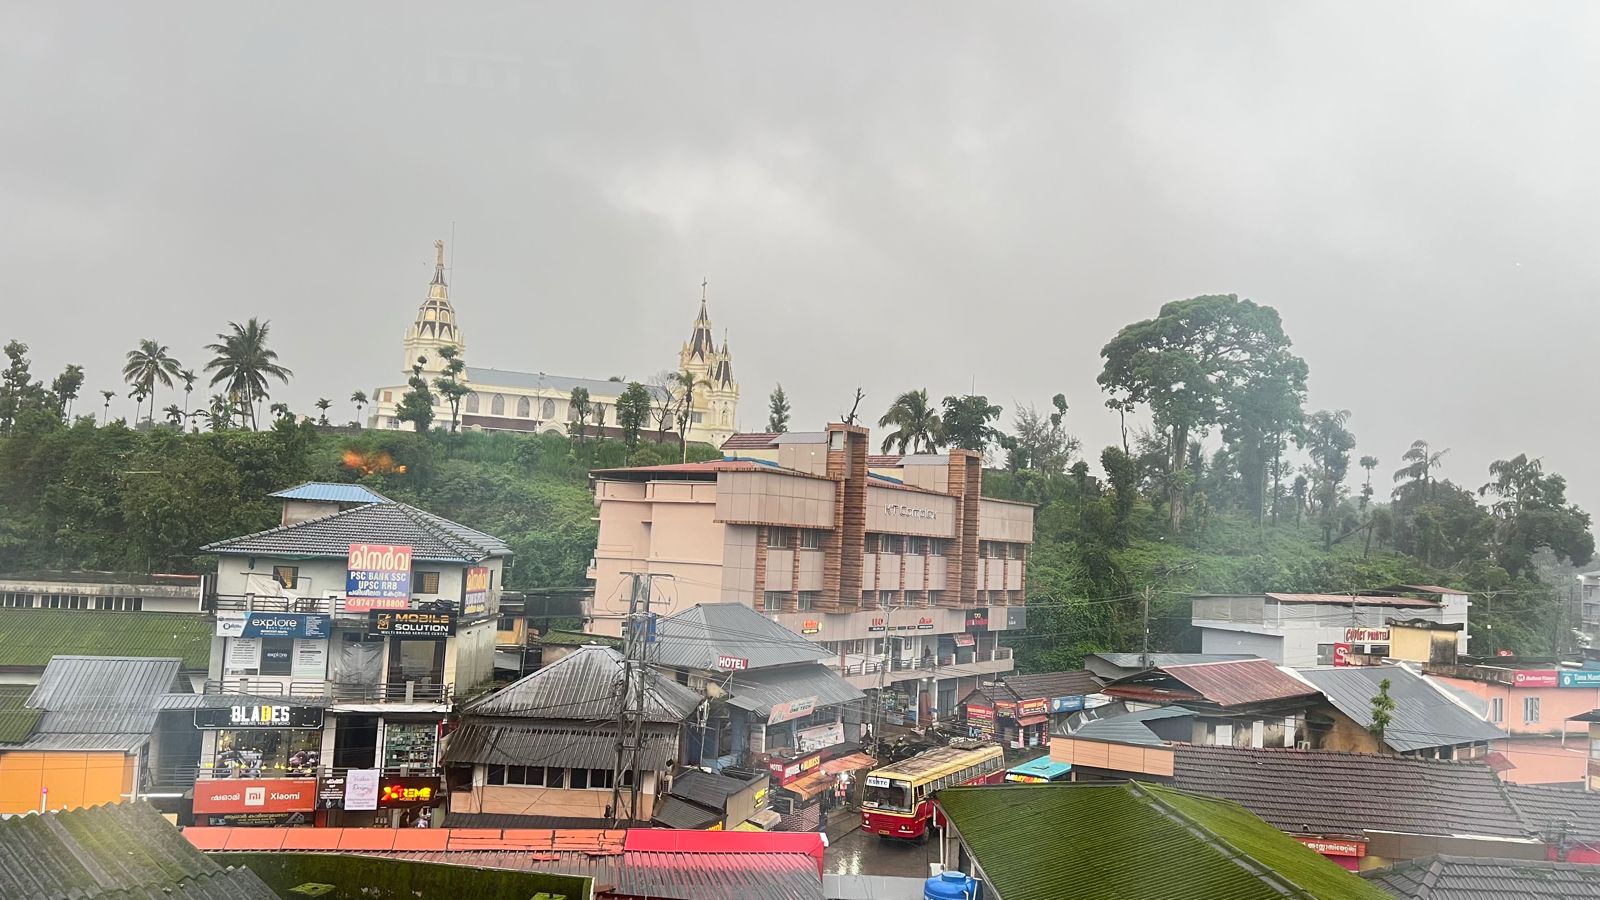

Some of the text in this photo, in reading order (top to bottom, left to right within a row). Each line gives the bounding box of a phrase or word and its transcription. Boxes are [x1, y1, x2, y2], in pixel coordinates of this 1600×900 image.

[350, 571, 407, 582] PSC BANK SSC
[358, 580, 398, 590] UPSC RRB
[252, 616, 297, 630] explore
[395, 613, 450, 624] MOBILE
[394, 624, 449, 632] SOLUTION
[719, 656, 746, 670] HOTEL
[231, 704, 290, 722] BLADES
[270, 792, 300, 801] Xiaomi
